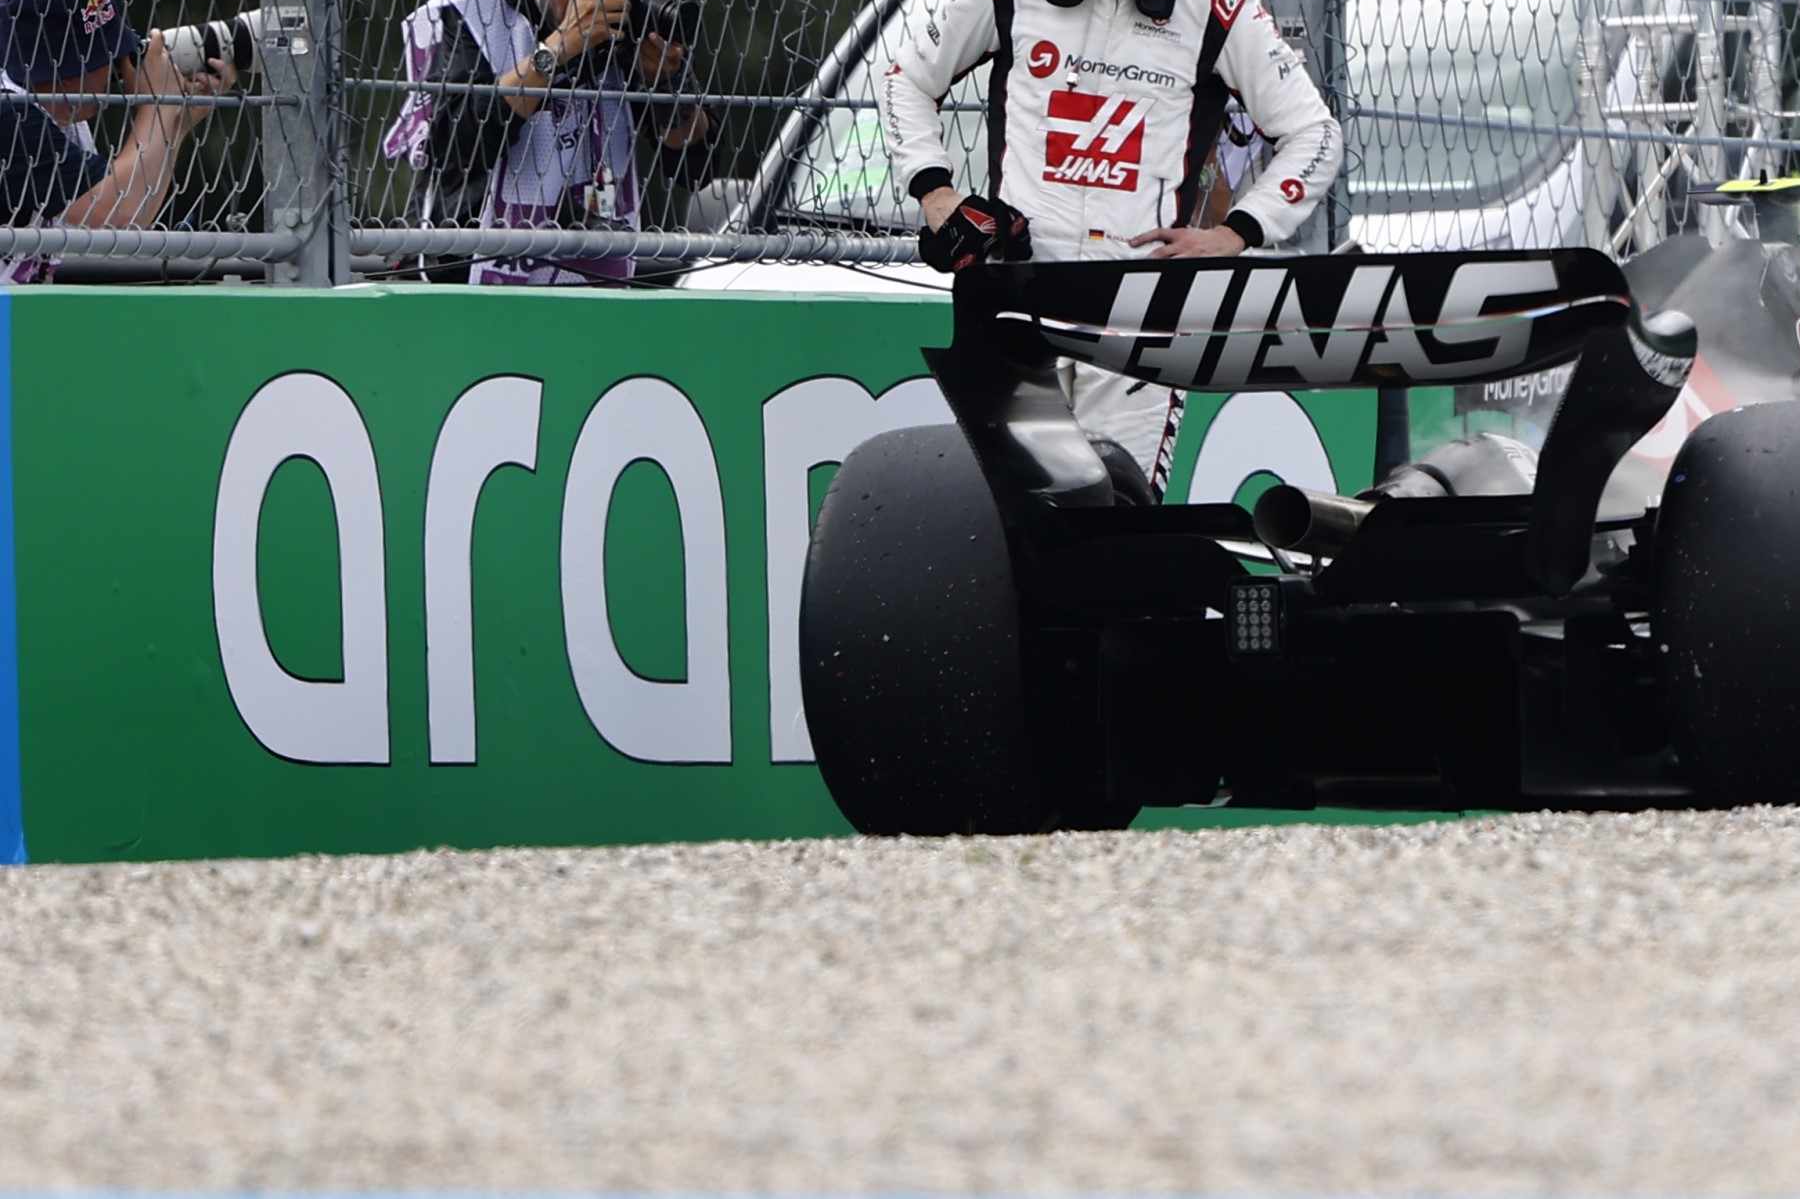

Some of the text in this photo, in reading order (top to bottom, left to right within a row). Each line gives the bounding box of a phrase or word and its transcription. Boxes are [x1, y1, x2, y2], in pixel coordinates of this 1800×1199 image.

[1064, 54, 1176, 88] MoneyGram
[1043, 155, 1140, 186] HAAS
[1040, 260, 1560, 386] HAAS
[1483, 366, 1573, 406] MoneyGra
